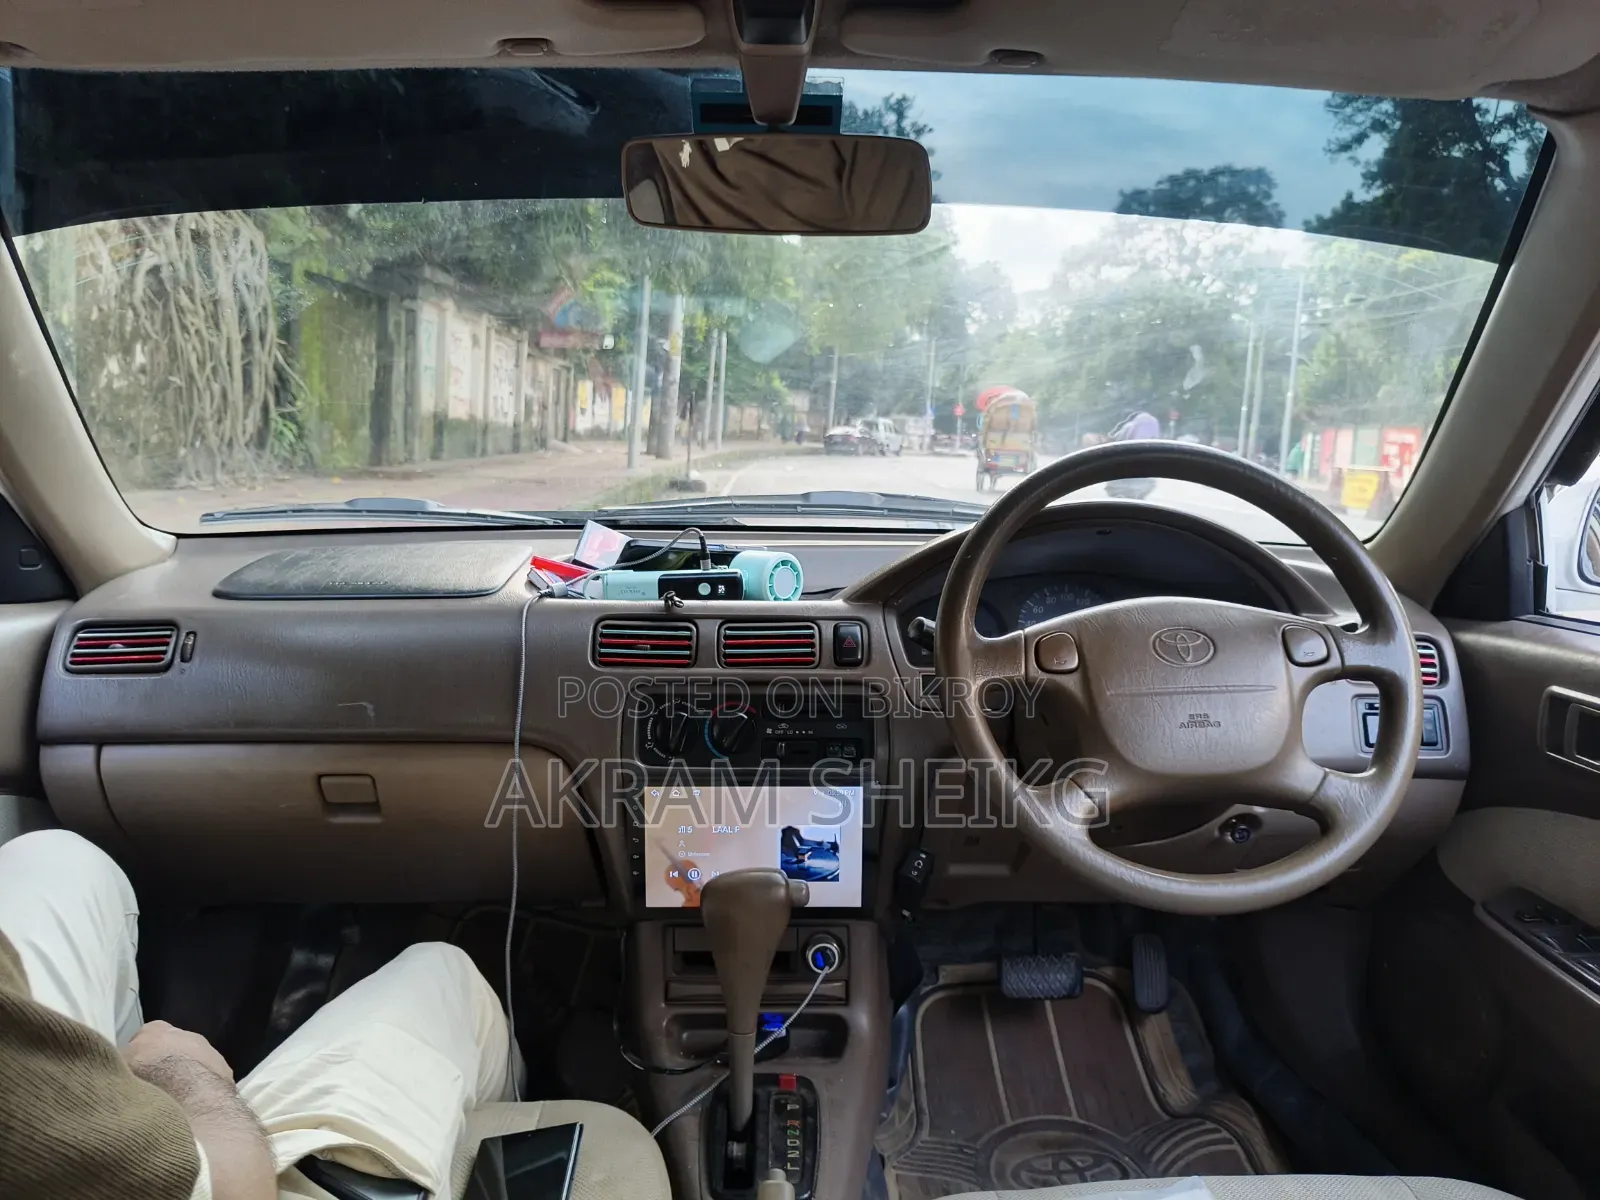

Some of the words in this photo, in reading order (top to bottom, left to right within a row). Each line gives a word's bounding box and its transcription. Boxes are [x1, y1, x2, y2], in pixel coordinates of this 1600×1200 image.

[1032, 606, 1044, 614] 60
[1179, 720, 1221, 728] AIRBAG
[712, 825, 733, 834] LAAL
[787, 1138, 800, 1146] D
[787, 1162, 800, 1170] L
